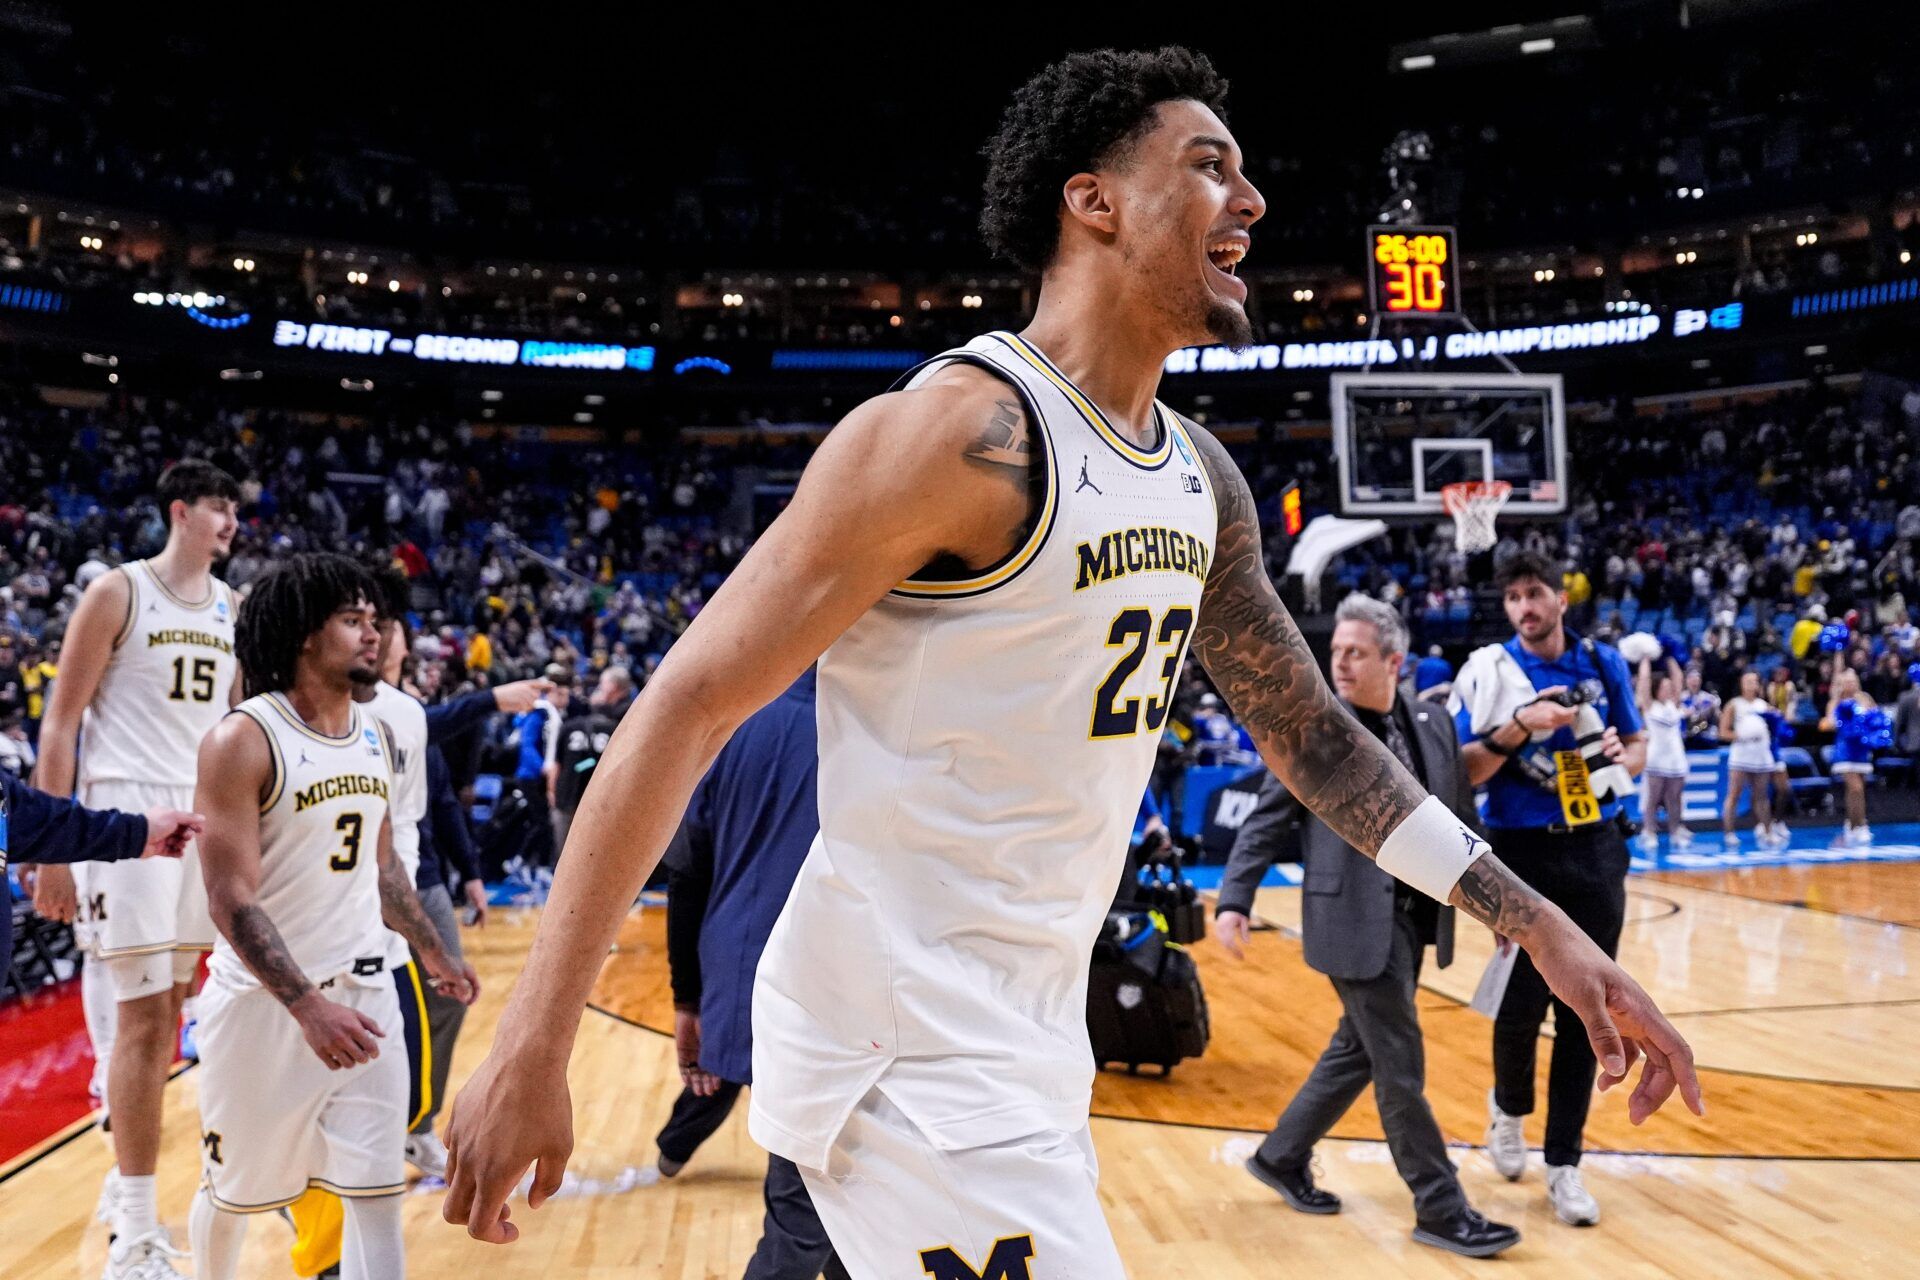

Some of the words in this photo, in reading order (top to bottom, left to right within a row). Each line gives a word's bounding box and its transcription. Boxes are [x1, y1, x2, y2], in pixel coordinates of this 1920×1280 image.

[1376, 235, 1447, 264] 26:00
[1385, 262, 1443, 311] 30
[307, 323, 391, 355] FIRST
[414, 333, 520, 365] SECOND
[1446, 314, 1660, 359] CHAMPIONSHIP
[168, 654, 217, 702] 15
[1087, 604, 1195, 741] 23
[329, 812, 363, 872] 3
